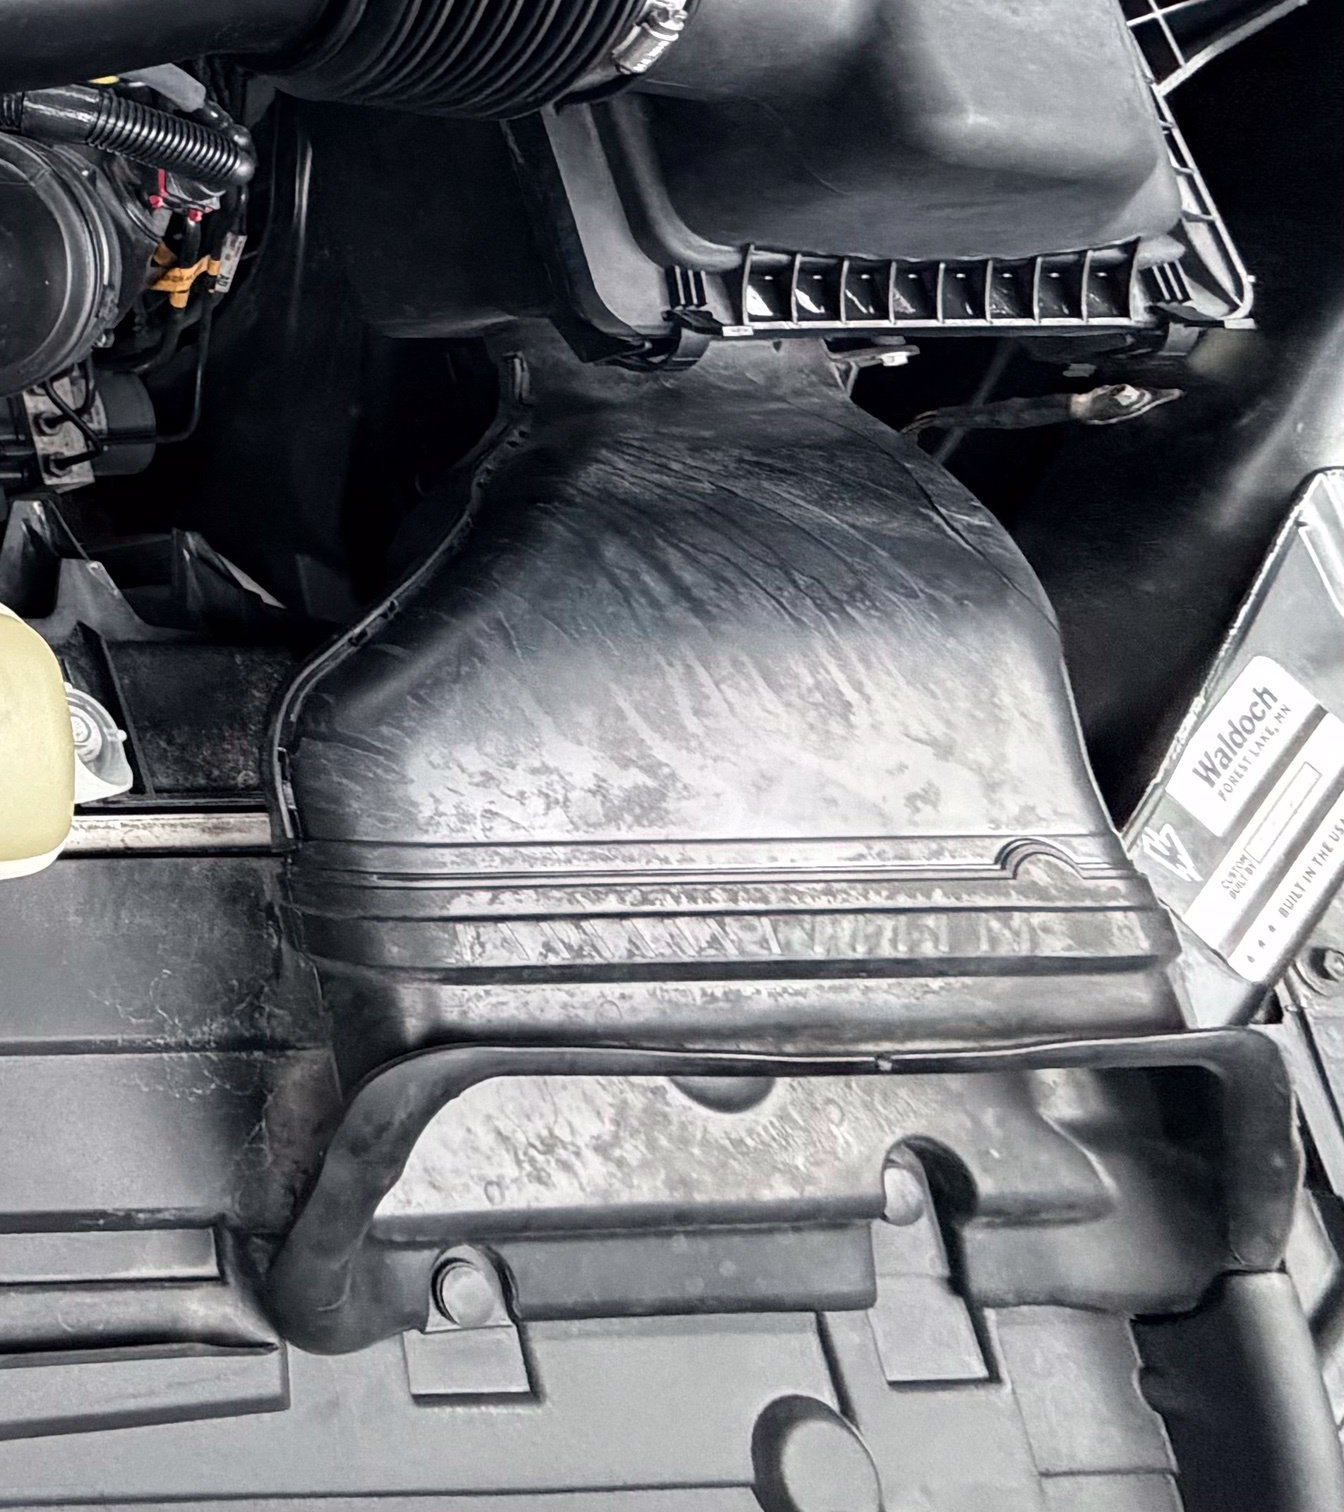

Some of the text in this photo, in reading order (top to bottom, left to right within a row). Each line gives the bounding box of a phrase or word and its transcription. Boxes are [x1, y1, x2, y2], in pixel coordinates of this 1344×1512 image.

[1192, 685, 1278, 790] Waldoch
[1218, 703, 1292, 802] FOREST LAKE, MN
[1221, 853, 1248, 890] CUSTOM
[1229, 867, 1249, 899] BUILT
[1278, 884, 1306, 918] BUILT
[1303, 869, 1317, 886] IN
[1312, 840, 1334, 868] THE
